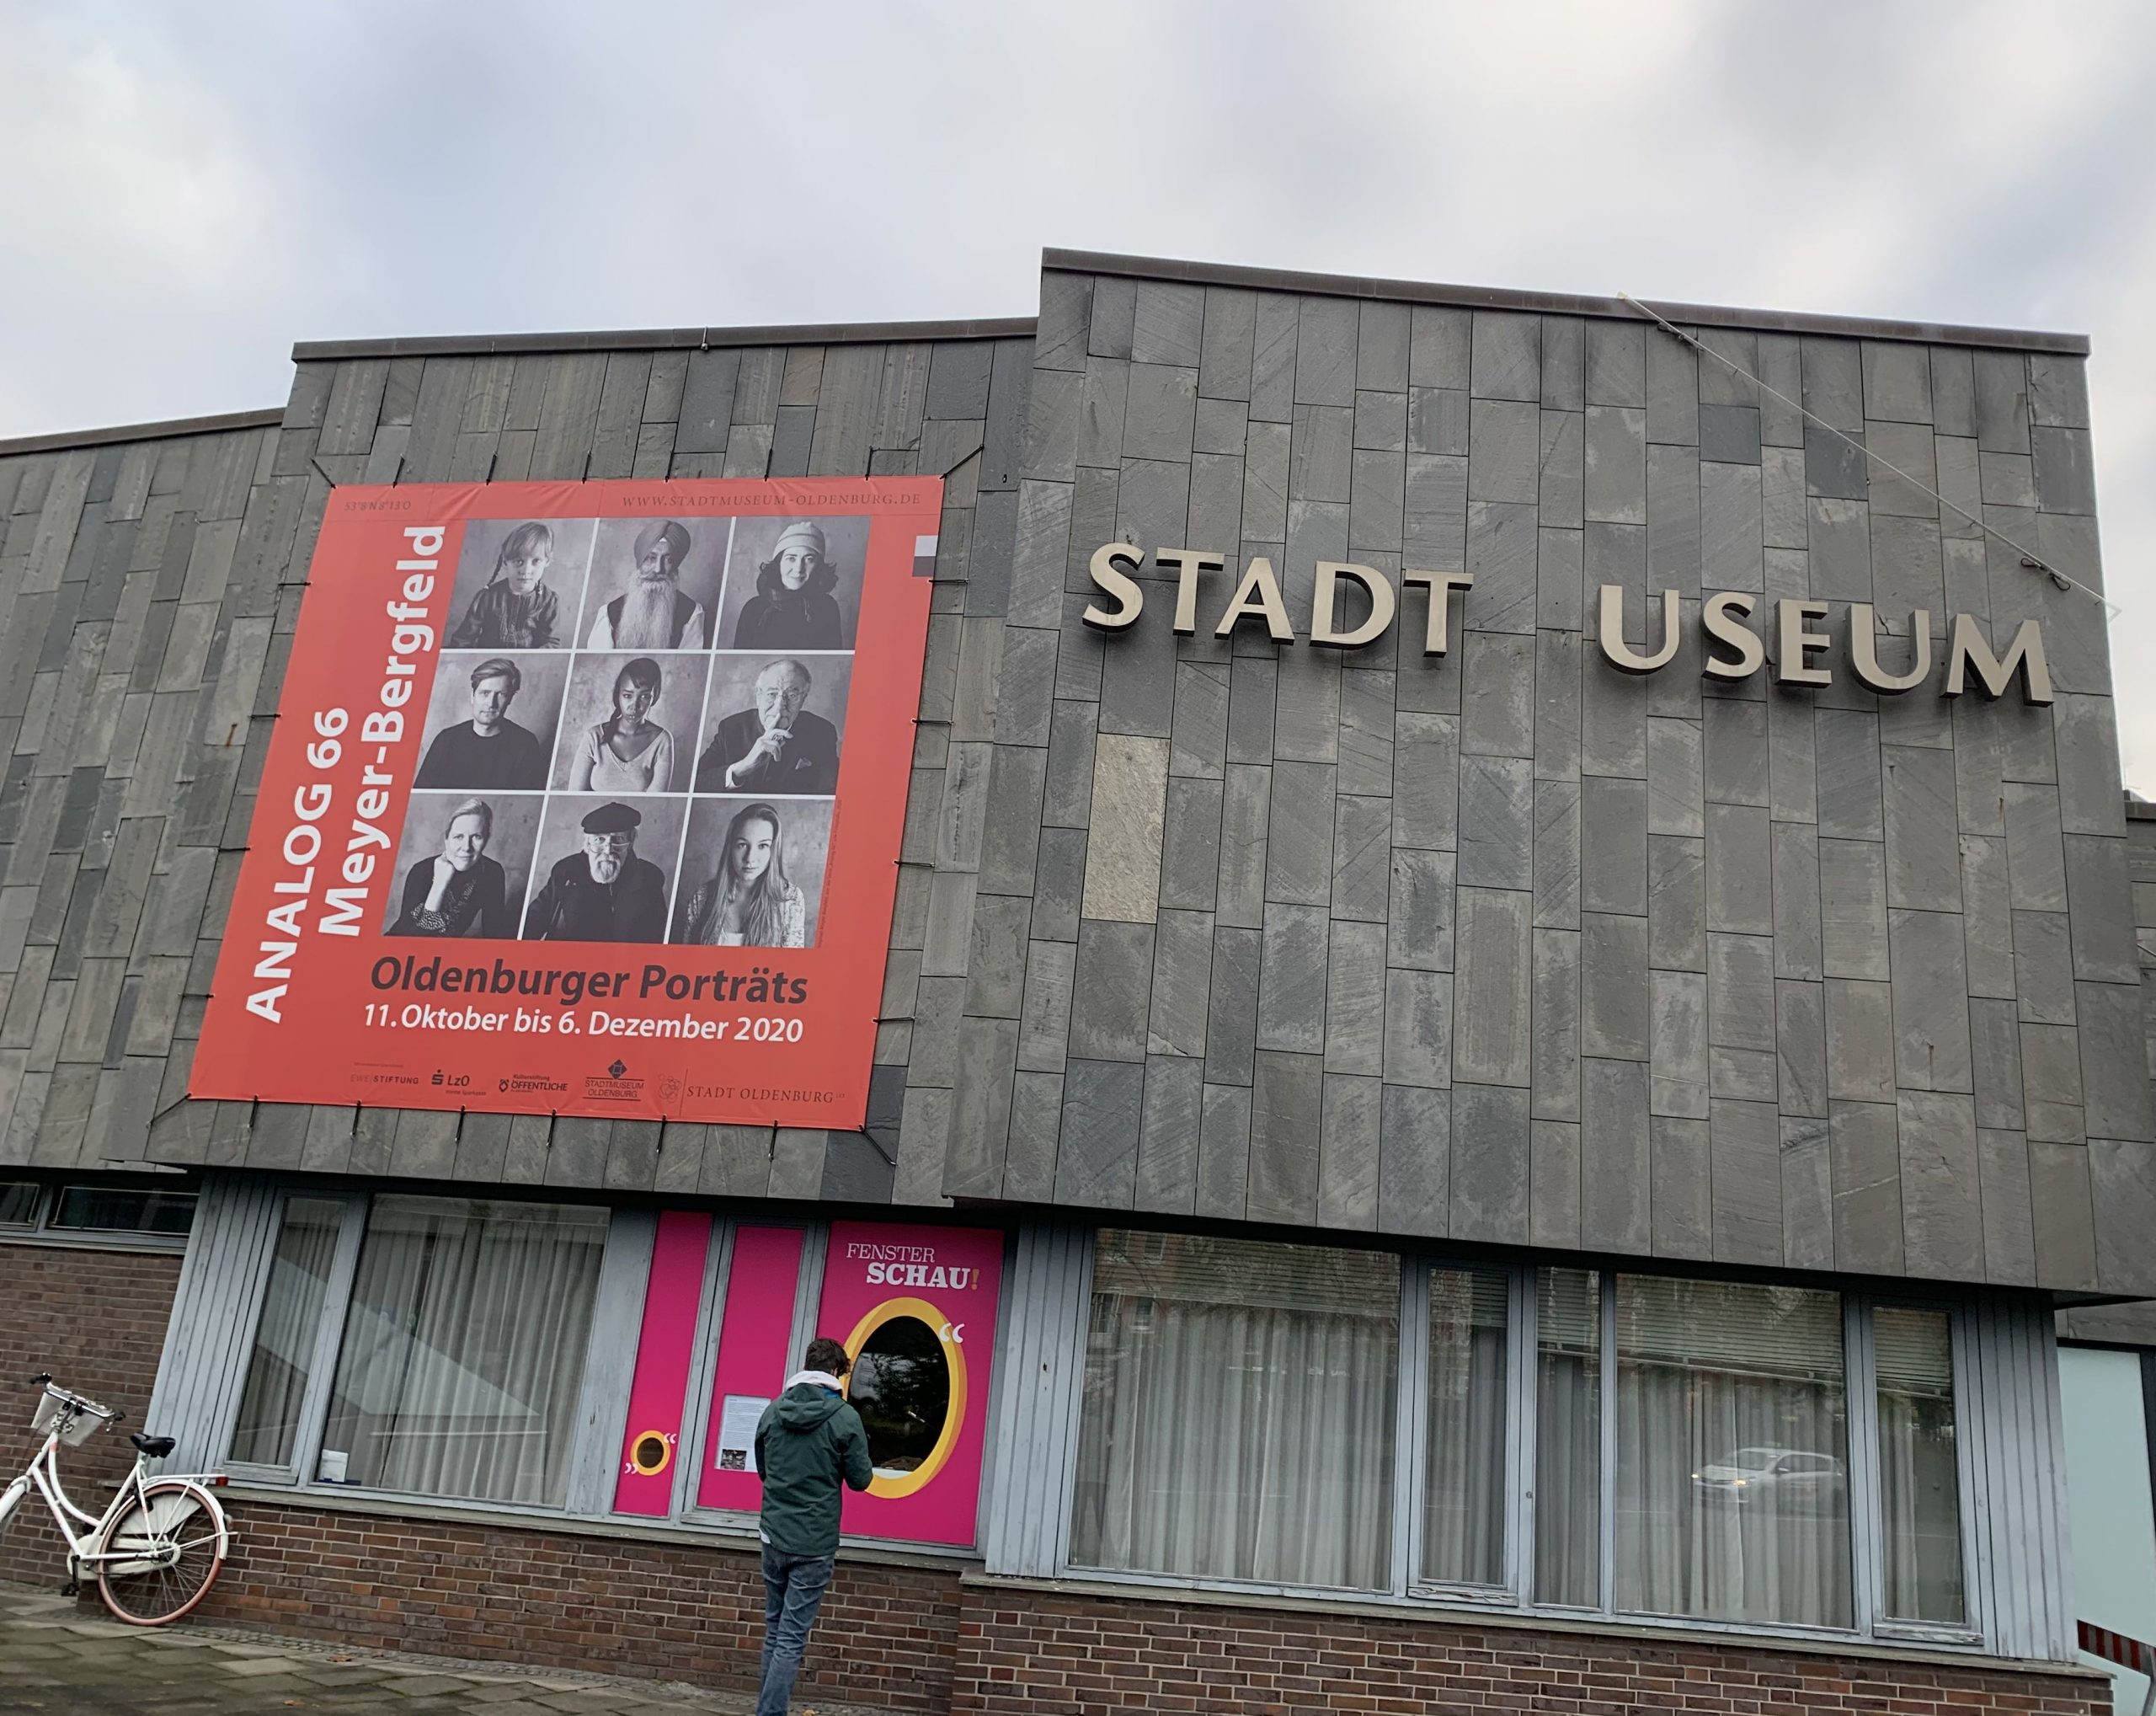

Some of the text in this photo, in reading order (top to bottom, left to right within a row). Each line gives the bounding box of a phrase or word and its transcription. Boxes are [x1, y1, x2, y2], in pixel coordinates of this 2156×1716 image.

[622, 494, 921, 507] WWW.STADTMUSEUM-OLDENBURG.DE
[1081, 543, 2055, 708] STADT USEUM
[318, 526, 446, 937] Meyer-Bergfeld
[246, 708, 349, 1024] ANALOG 66
[371, 955, 808, 1005] Oldenburger Porträts
[514, 1008, 552, 1034] bis
[558, 1010, 581, 1034] 6.
[589, 1011, 729, 1040] Dezember
[734, 1016, 803, 1043] 2020
[447, 1074, 471, 1087] LzO
[510, 1079, 568, 1092] ÖFFENTLICHE
[585, 1080, 644, 1090] STADTMUSEUM
[587, 1088, 638, 1099] OLDENBURG
[687, 1085, 734, 1099] STADT
[740, 1088, 834, 1103] OLDENBURG
[846, 1243, 936, 1263] FENSTER
[866, 1262, 980, 1291] SCHAU!
